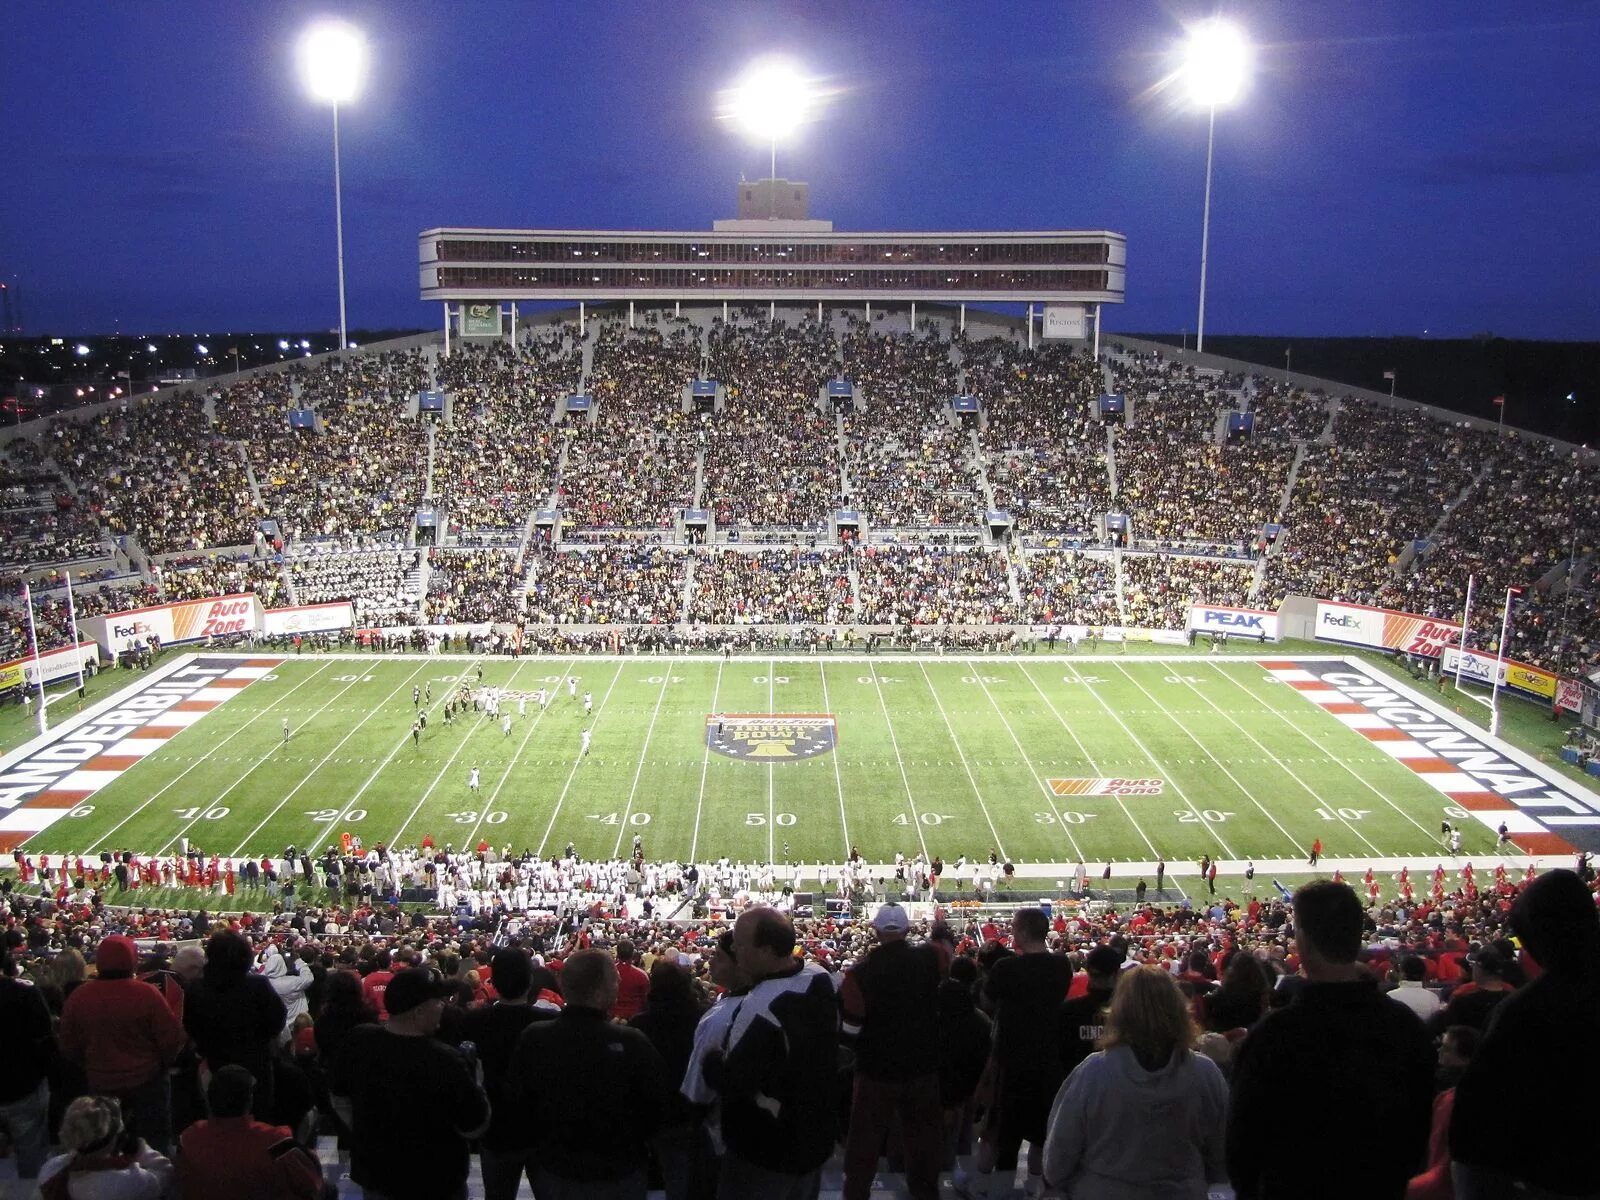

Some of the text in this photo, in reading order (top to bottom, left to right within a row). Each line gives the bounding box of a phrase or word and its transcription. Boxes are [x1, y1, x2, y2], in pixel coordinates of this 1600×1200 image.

[207, 601, 250, 619] Auto
[1204, 610, 1264, 629] PEAK
[1323, 612, 1361, 629] FedEx
[114, 621, 152, 638] FedEx
[201, 618, 246, 636] Zone
[1449, 656, 1490, 678] PEAK
[1563, 686, 1581, 699] Auto
[1559, 695, 1578, 708] Zone
[733, 731, 811, 741] BOWL
[1108, 779, 1163, 787] Auto
[1100, 786, 1161, 795] Zone
[181, 807, 230, 820] 10
[312, 809, 368, 823] 20
[454, 811, 509, 824] 30
[598, 812, 652, 825] 40
[745, 813, 798, 826] 50
[891, 812, 943, 826] 40
[1034, 811, 1086, 824] 30
[1173, 809, 1226, 823] 20
[1313, 807, 1361, 820] 10
